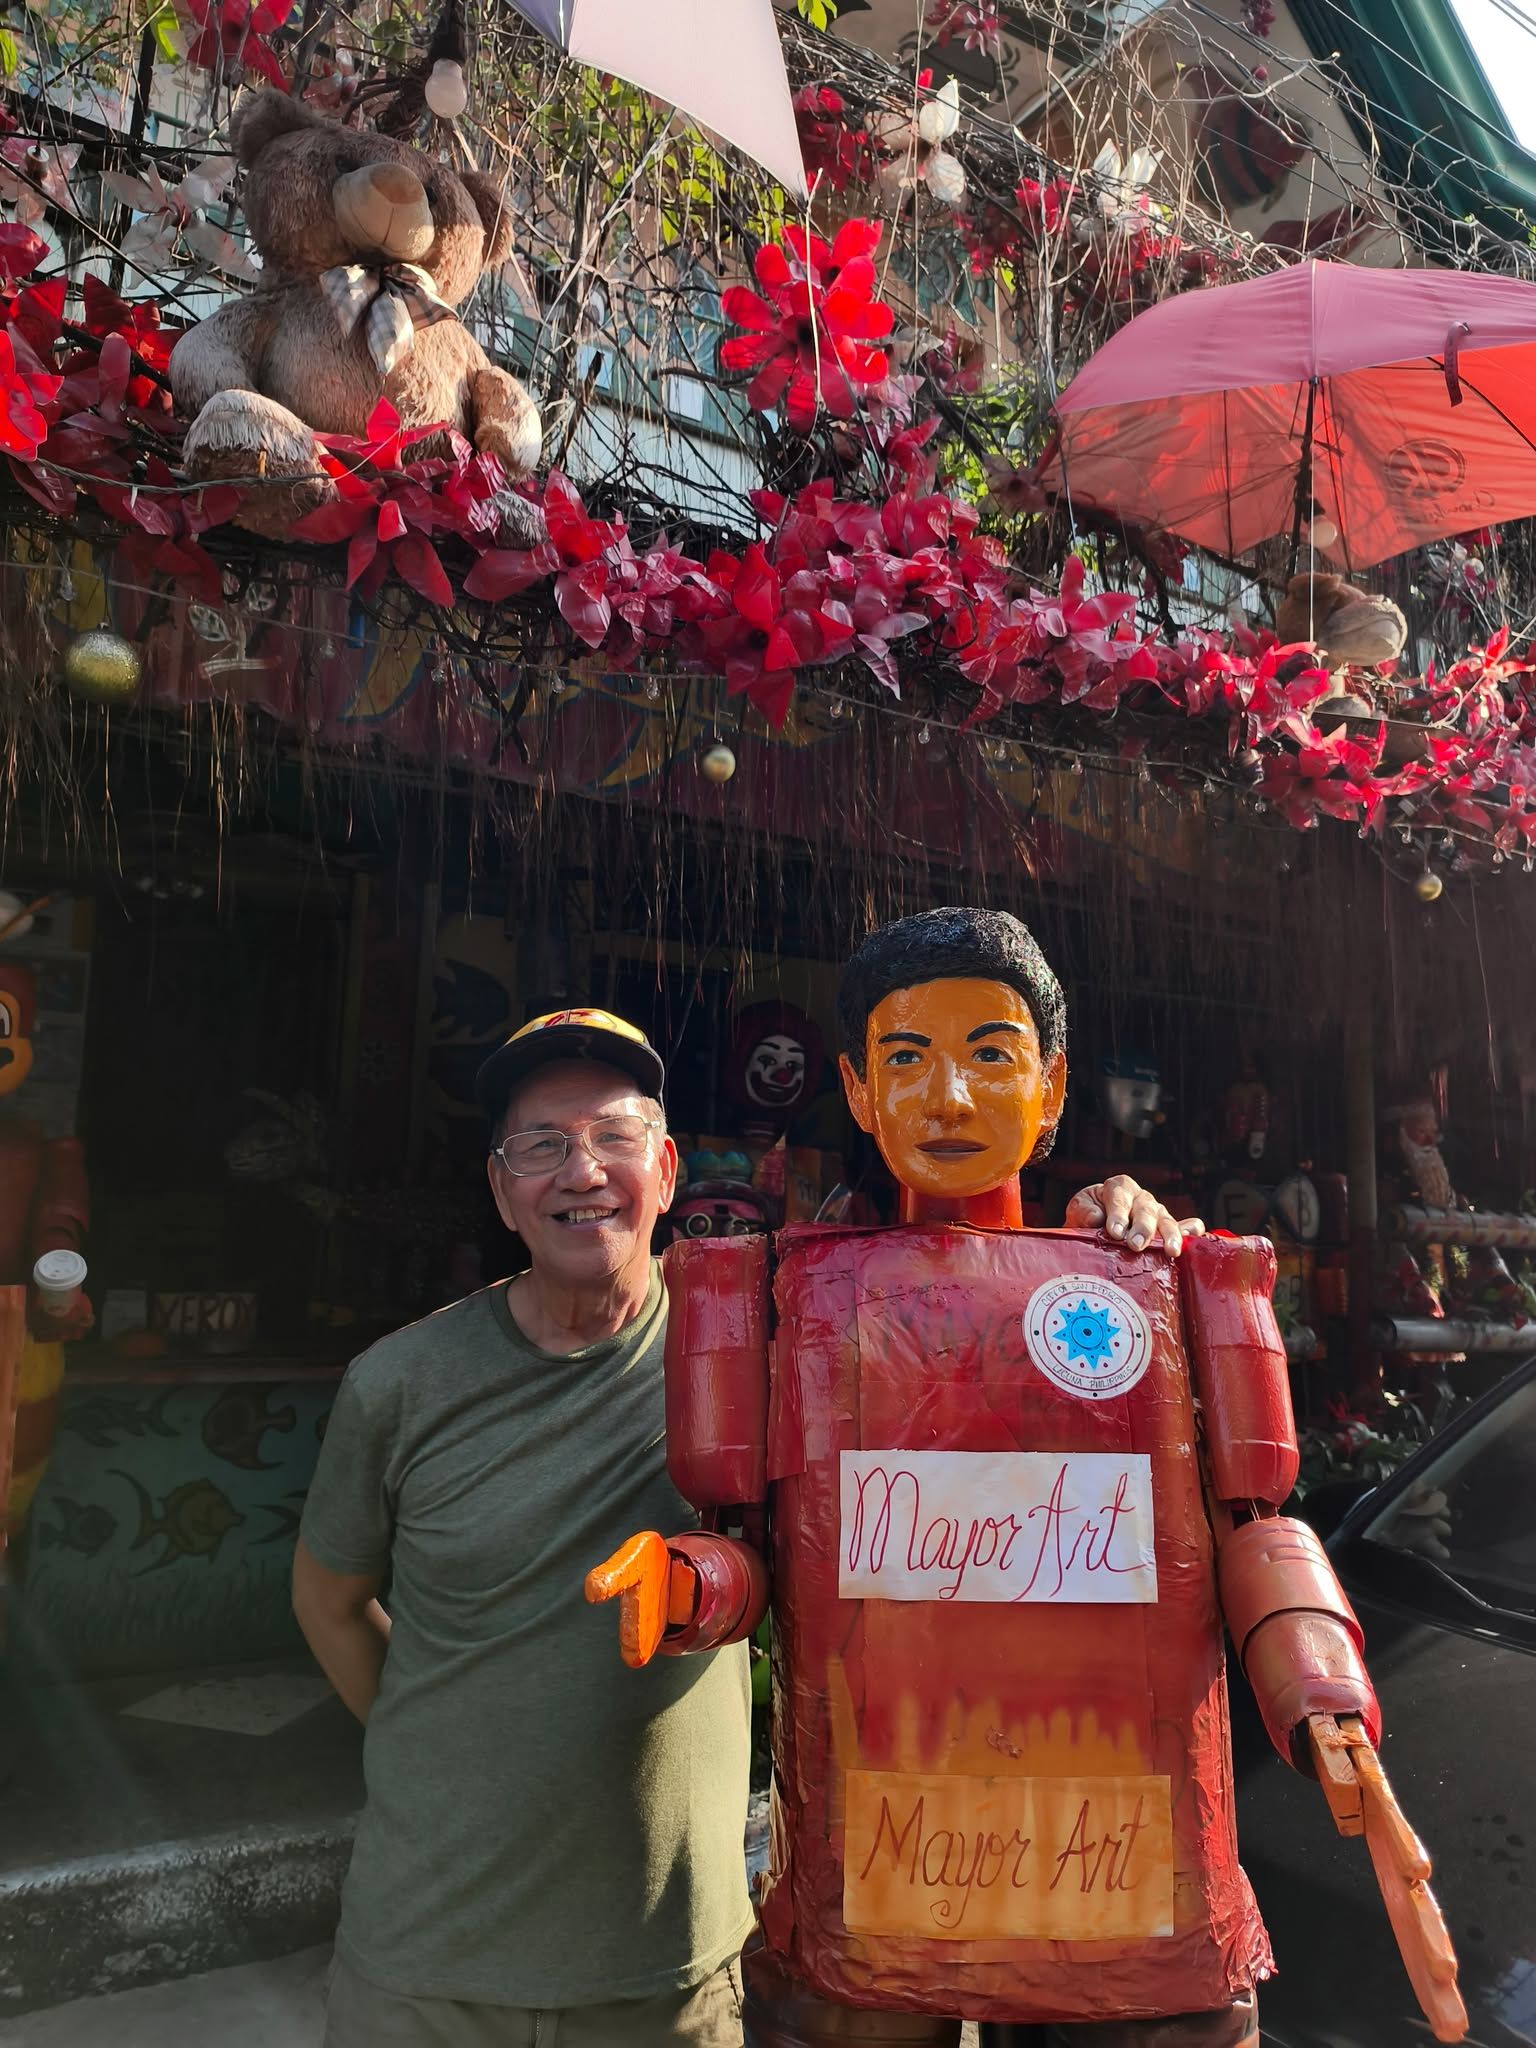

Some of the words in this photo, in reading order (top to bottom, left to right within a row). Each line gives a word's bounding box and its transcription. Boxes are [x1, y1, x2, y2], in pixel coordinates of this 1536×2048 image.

[1052, 1363, 1083, 1387] LAGUNA
[847, 1466, 1021, 1600] Mayor
[1013, 1462, 1146, 1601] Art
[859, 1794, 1032, 1929] Mayor
[1049, 1794, 1146, 1894] Art
